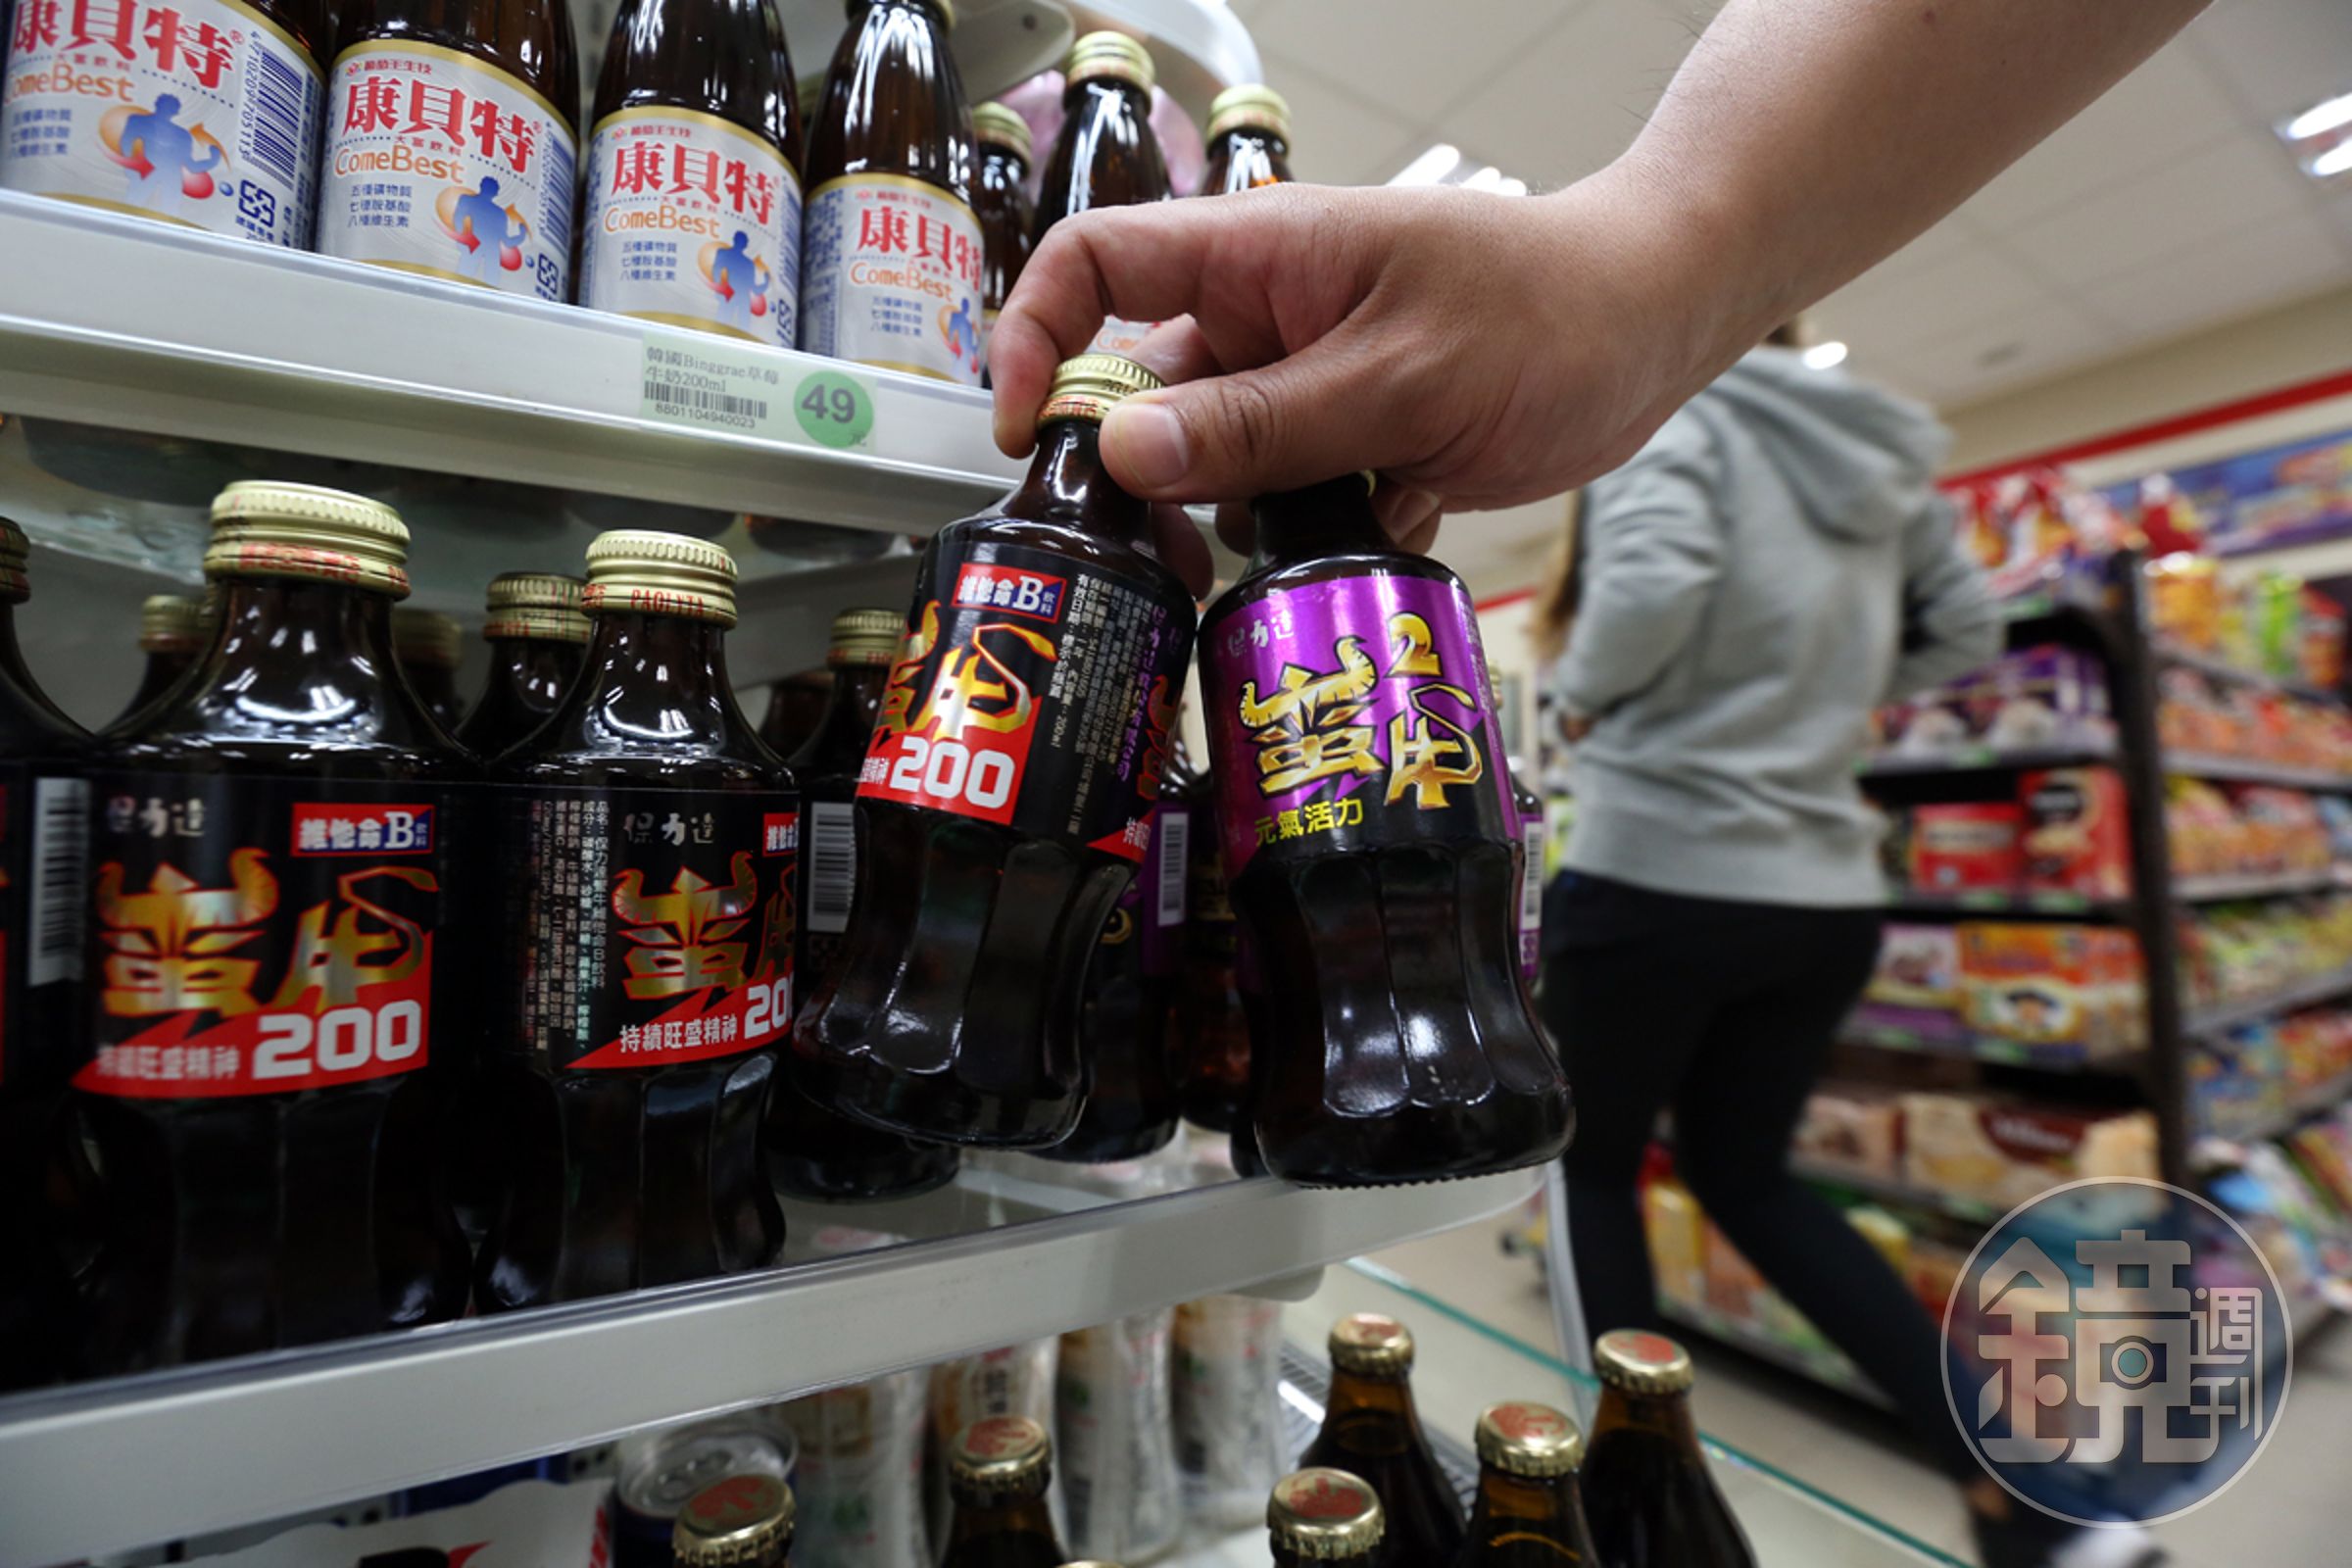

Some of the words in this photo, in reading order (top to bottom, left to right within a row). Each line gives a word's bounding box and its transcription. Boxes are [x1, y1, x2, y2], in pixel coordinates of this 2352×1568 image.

[11, 0, 234, 89] 康貝特
[343, 76, 535, 173] 康貝特
[334, 145, 466, 184] ComeBest
[611, 140, 776, 225] 康貝特
[604, 204, 721, 239] ComeBest
[858, 205, 981, 293] 康貝特
[850, 262, 953, 302] ComeBest
[801, 383, 856, 424] 49
[889, 735, 1016, 810] 200
[1253, 797, 1364, 847] 元氣活力
[252, 999, 421, 1080] 200
[620, 1014, 738, 1054] 持續旺盛精神
[744, 972, 794, 1040] 20
